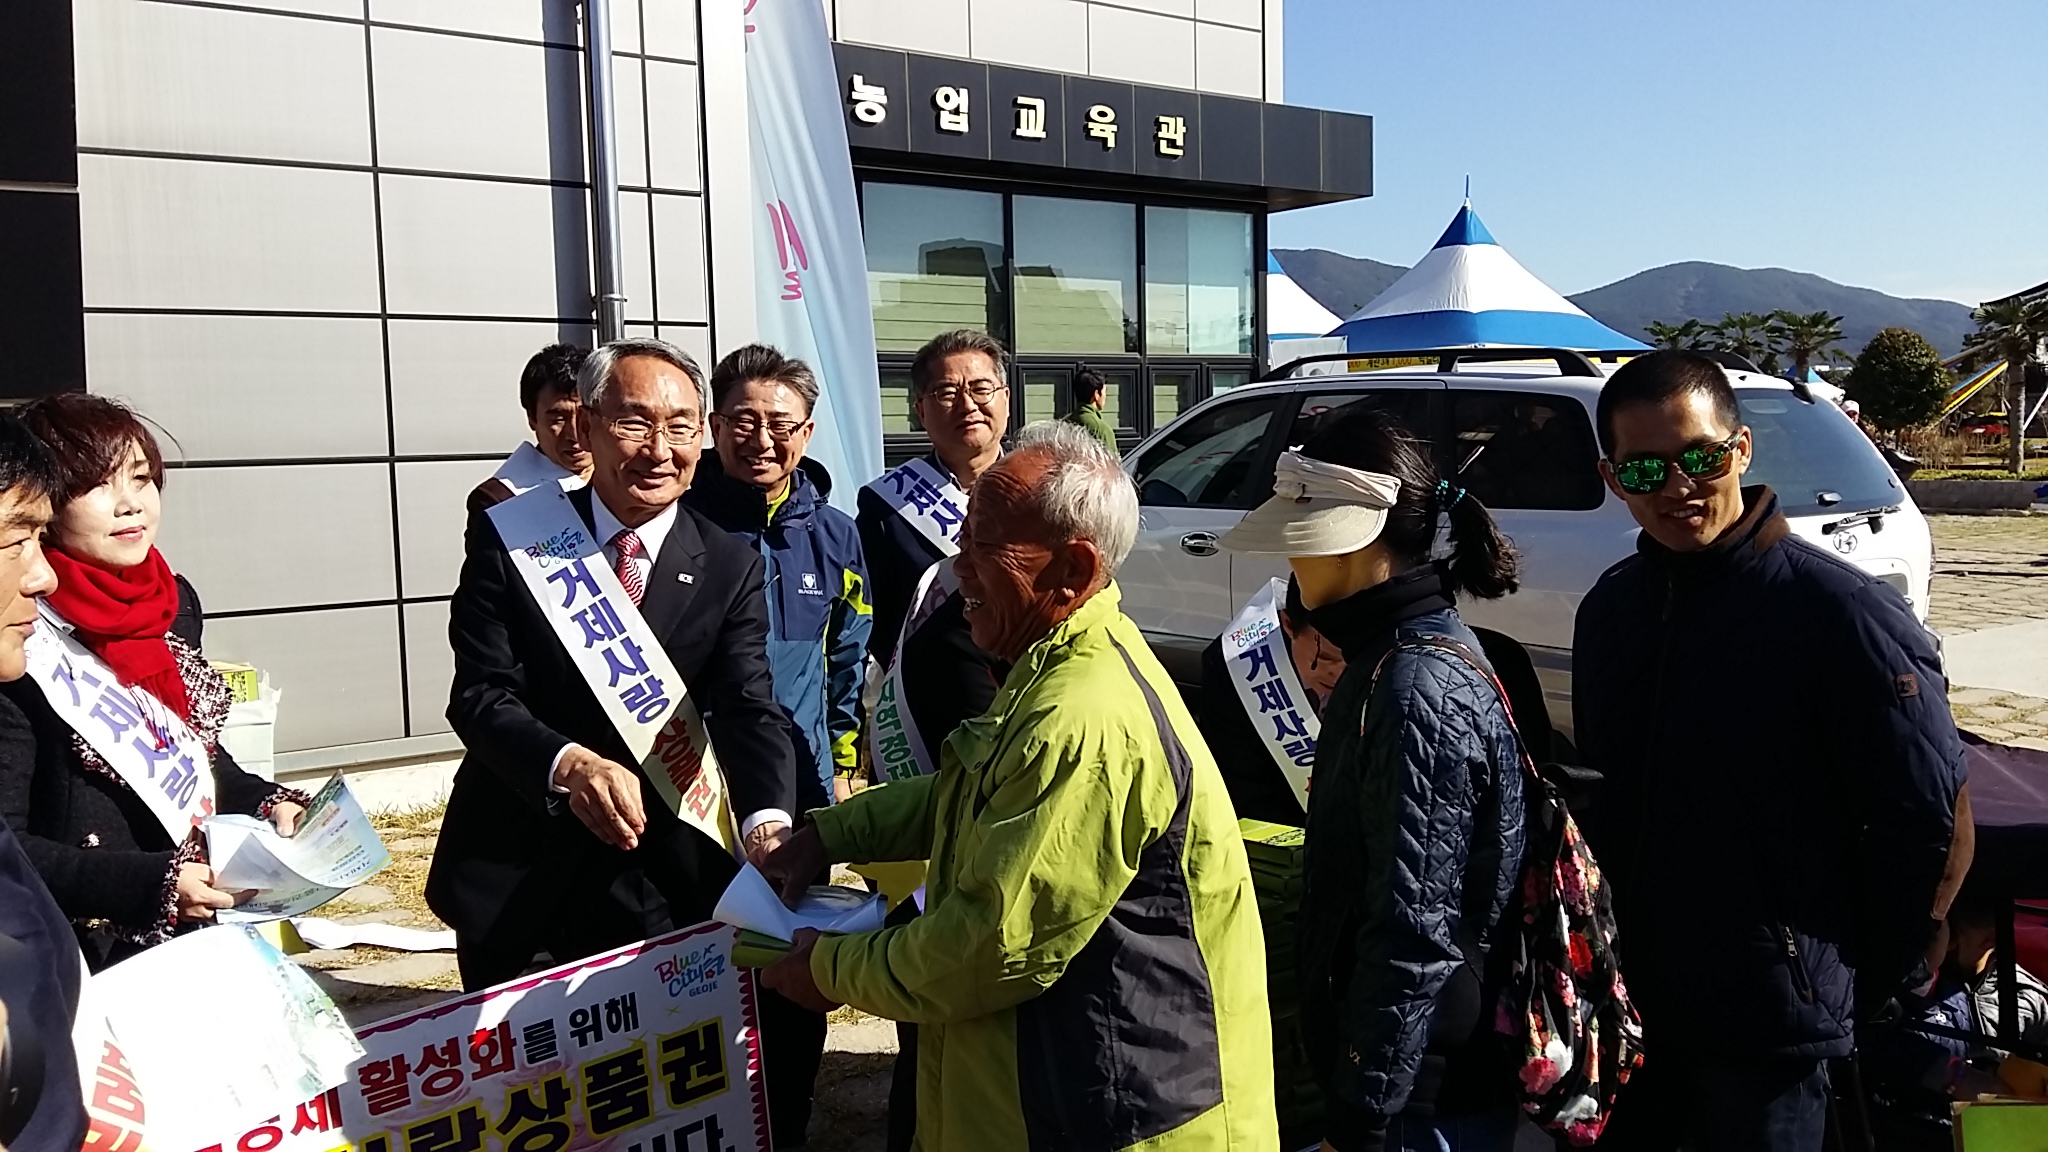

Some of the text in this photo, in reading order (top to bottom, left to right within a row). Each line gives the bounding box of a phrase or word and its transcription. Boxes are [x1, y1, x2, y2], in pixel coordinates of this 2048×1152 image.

[851, 73, 1187, 156] 농업교육관
[883, 465, 965, 549] 거제사
[522, 535, 560, 561] Blue
[538, 542, 567, 568] City
[1229, 622, 1257, 641] Blue
[1237, 629, 1260, 648] City
[653, 950, 702, 984] Blue
[668, 963, 704, 997] City
[689, 980, 719, 997] GEOJE
[357, 1018, 560, 1116] 활성화를
[569, 991, 641, 1048] 위해
